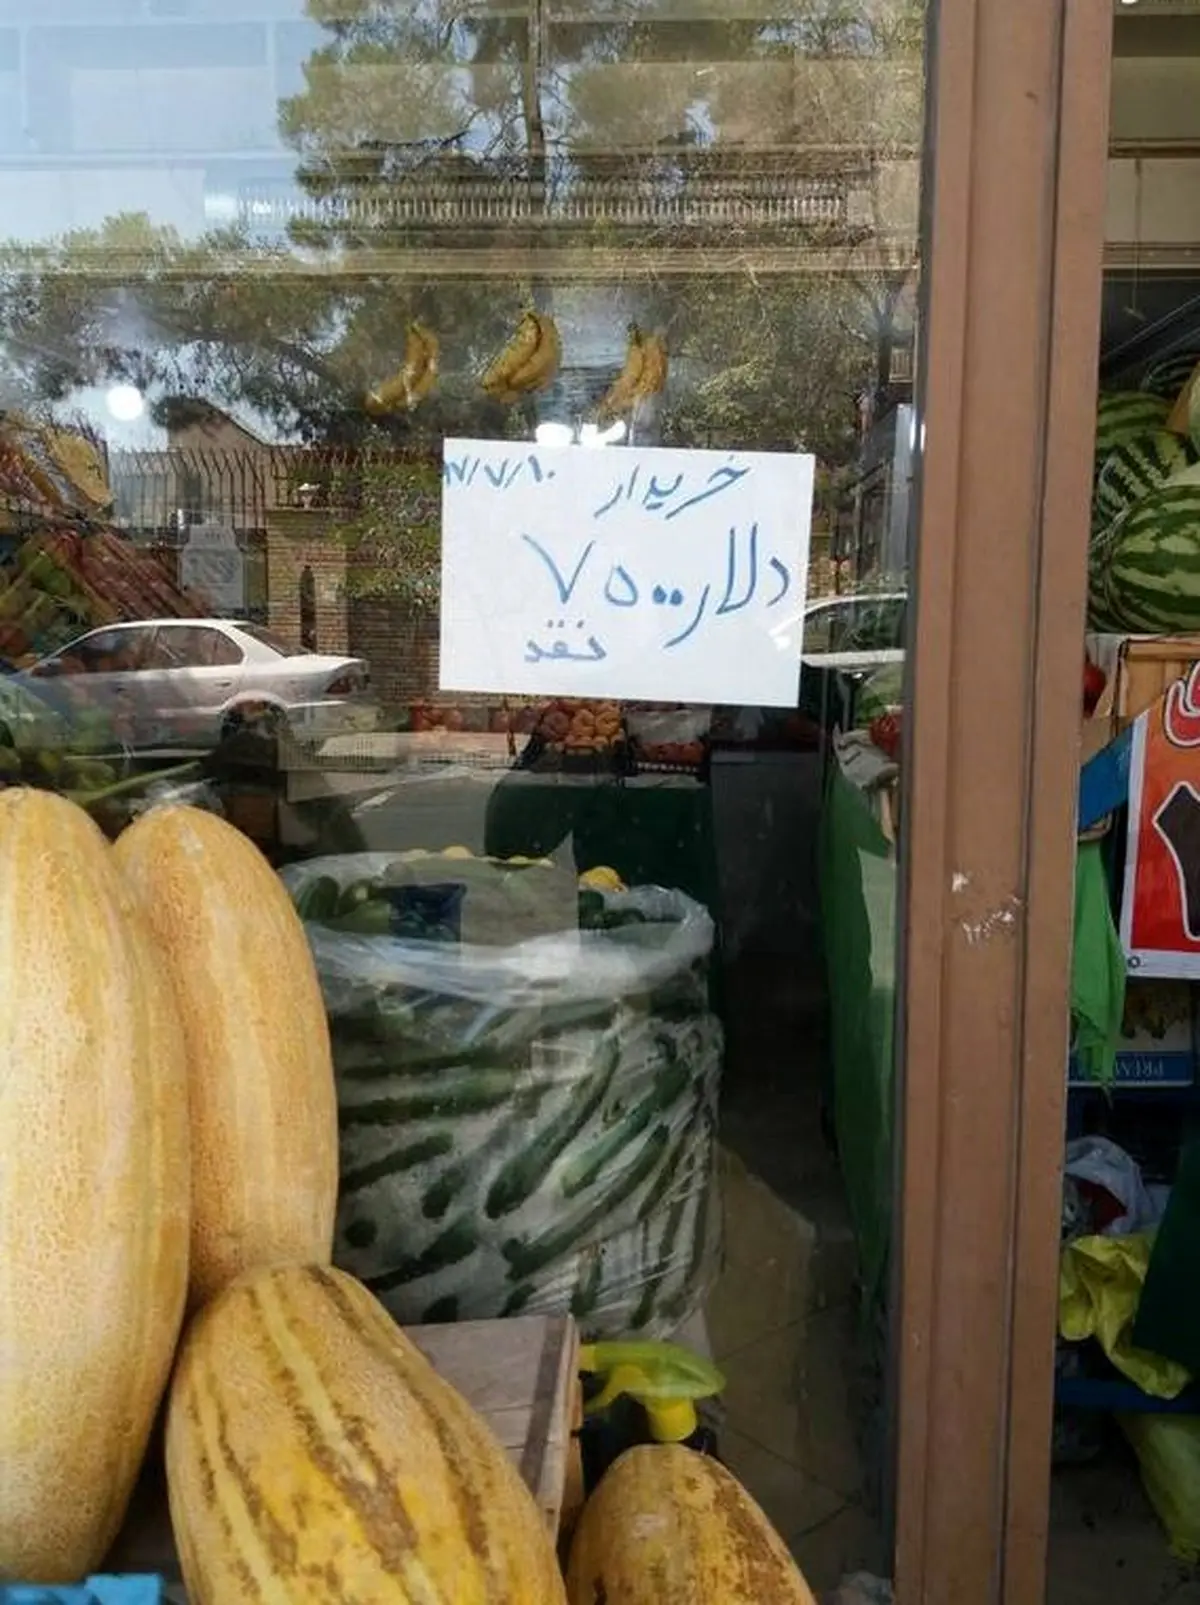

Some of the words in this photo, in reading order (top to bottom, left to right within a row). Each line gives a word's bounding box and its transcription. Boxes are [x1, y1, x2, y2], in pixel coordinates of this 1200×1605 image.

[593, 456, 751, 519] خریدار
[521, 532, 685, 608] ۷۵۰۰
[663, 522, 791, 649] دلار
[523, 618, 608, 663] نقد
